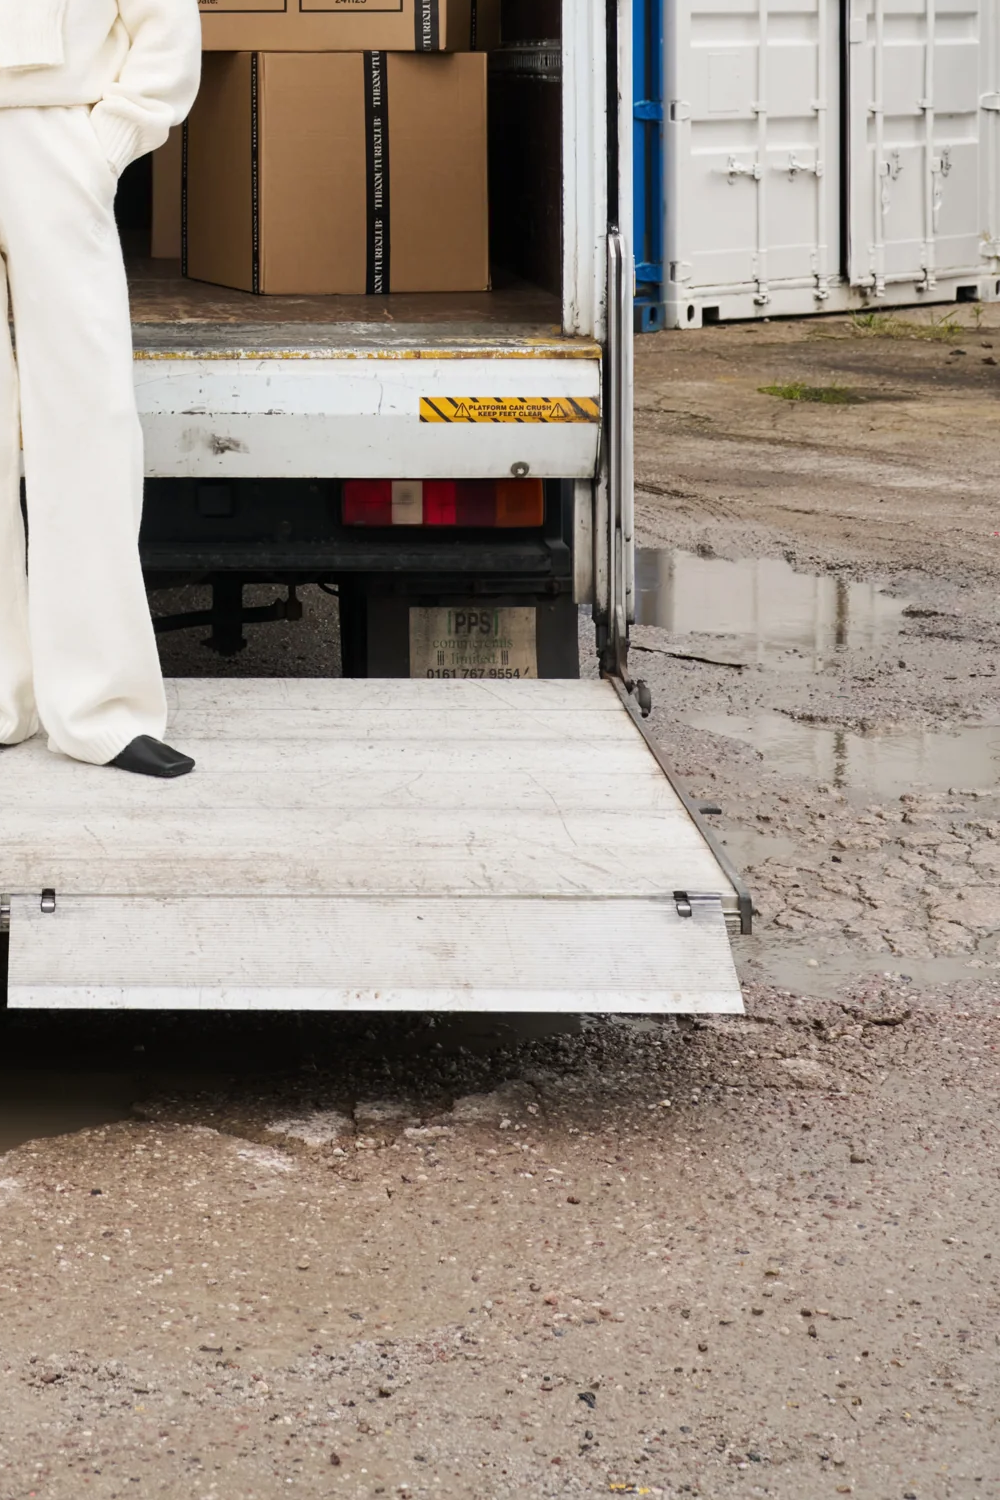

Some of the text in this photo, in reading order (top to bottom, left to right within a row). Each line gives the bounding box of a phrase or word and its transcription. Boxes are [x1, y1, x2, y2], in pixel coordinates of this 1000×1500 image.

[455, 611, 491, 635] PPS
[426, 668, 521, 679] 0161 767 9554
